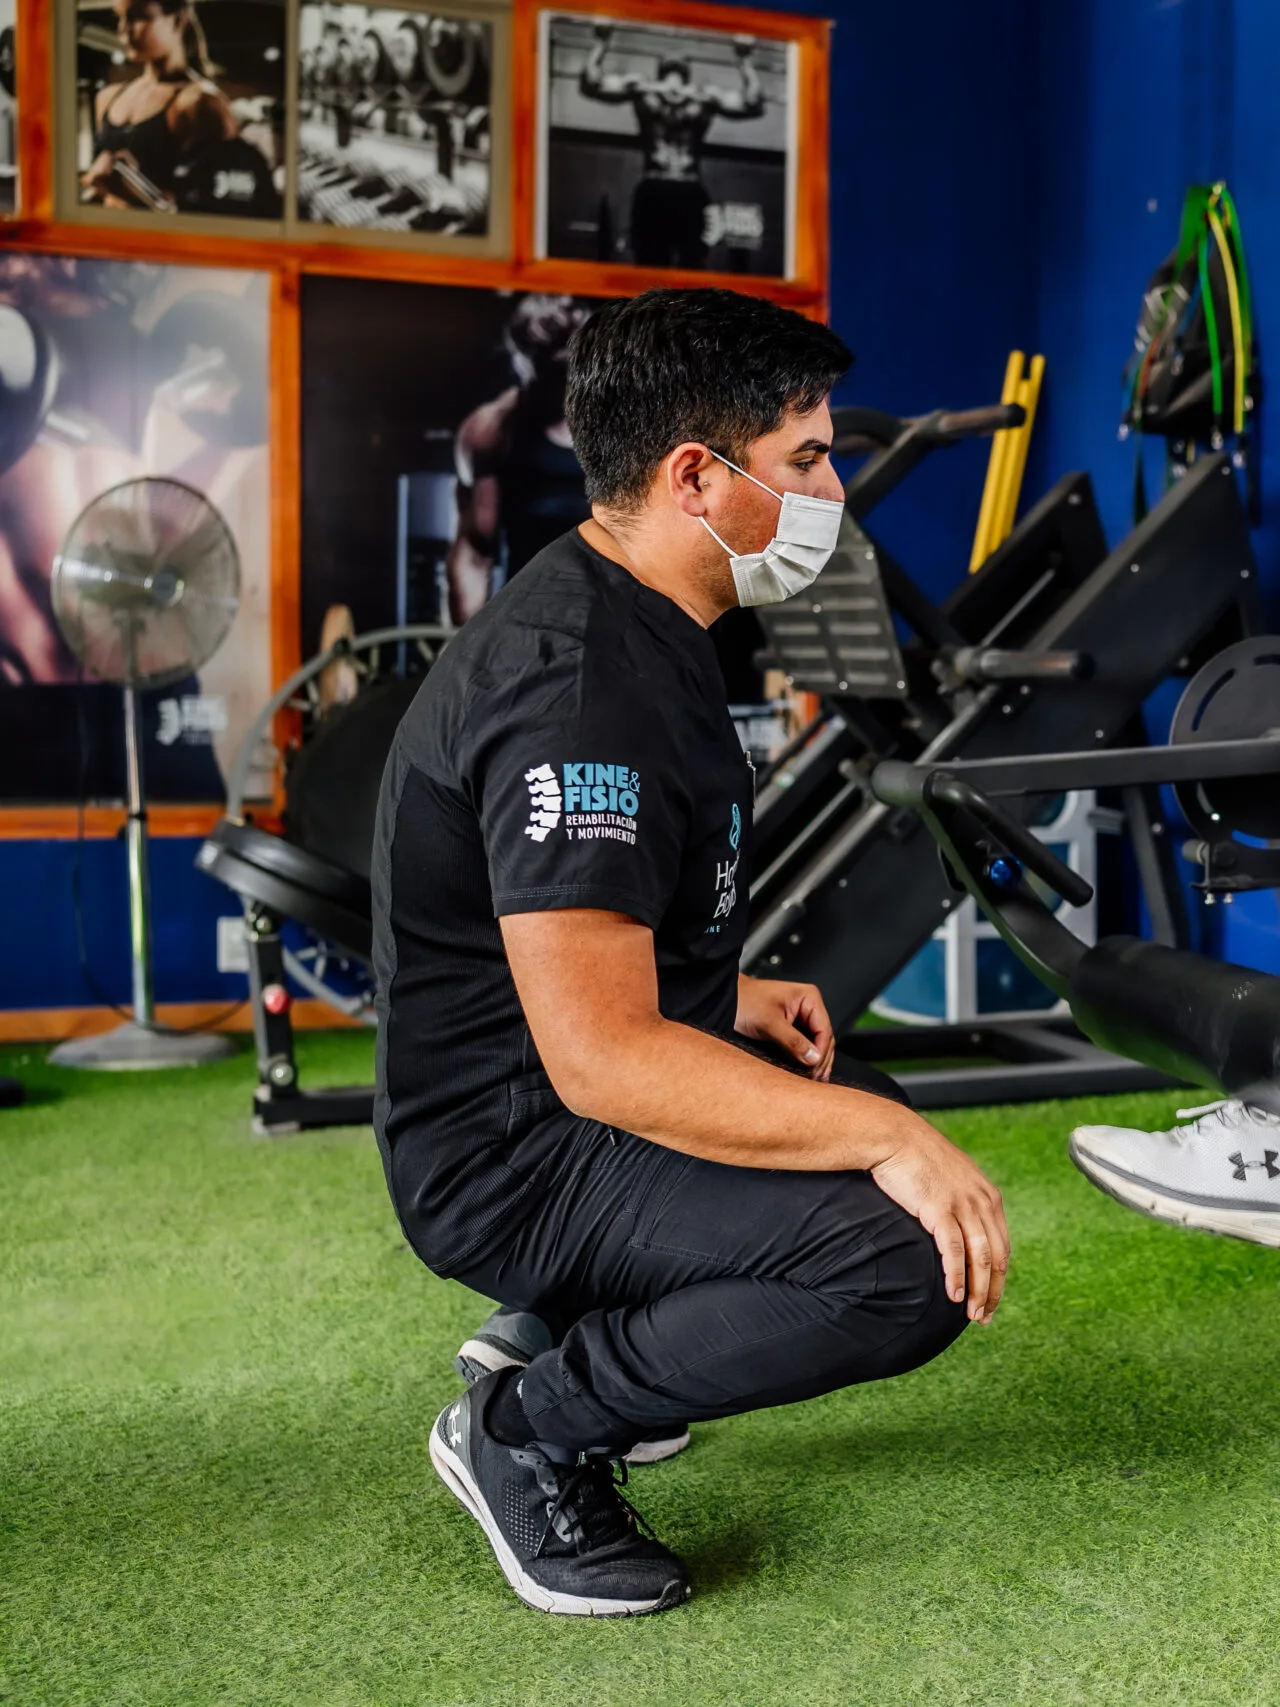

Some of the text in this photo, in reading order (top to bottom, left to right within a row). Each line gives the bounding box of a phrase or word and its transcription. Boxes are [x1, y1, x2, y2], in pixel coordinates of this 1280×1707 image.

[564, 786, 639, 817] FISIO
[565, 813, 637, 832] REHABILITACIÓN
[566, 826, 636, 845] Y MOVIMIENTO
